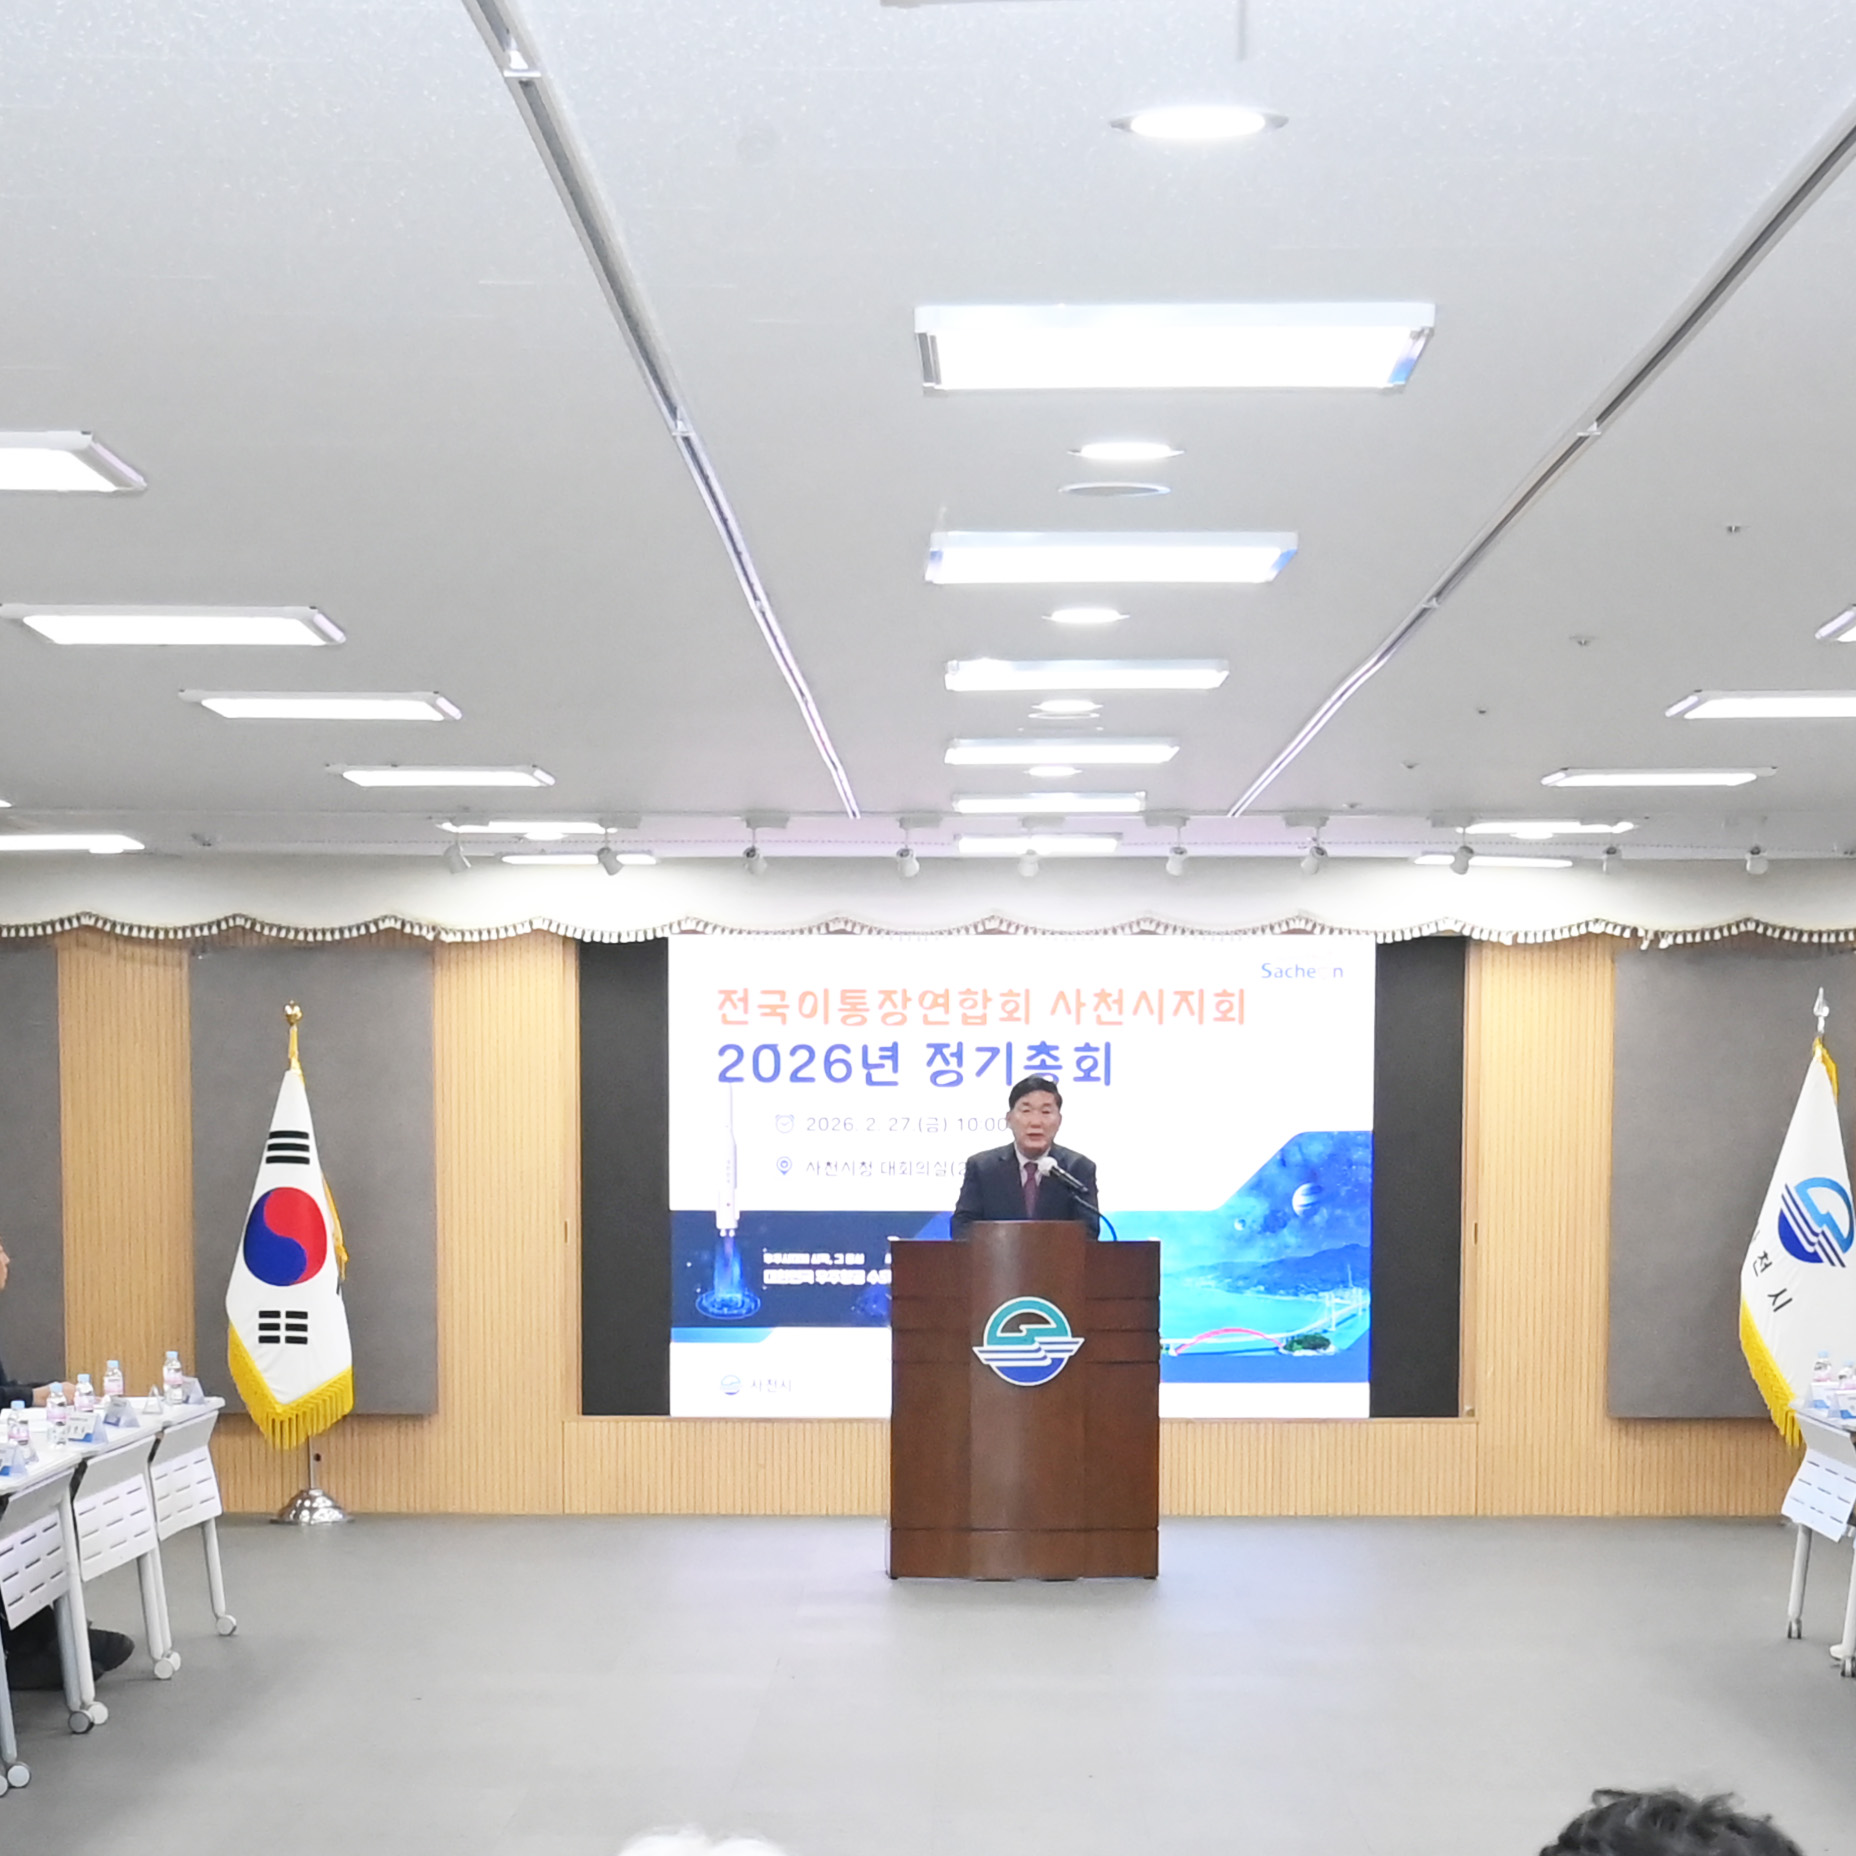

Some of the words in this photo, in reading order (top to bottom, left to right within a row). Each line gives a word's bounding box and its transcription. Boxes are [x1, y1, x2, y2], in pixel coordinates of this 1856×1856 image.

[1261, 962, 1343, 979] Sachen
[717, 987, 1031, 1027] 전국이통장연합회
[1049, 987, 1245, 1027] 사천시지회
[717, 1041, 900, 1086] 2026년
[925, 1040, 1112, 1087] 정기총회
[805, 1160, 874, 1178] 사천시청
